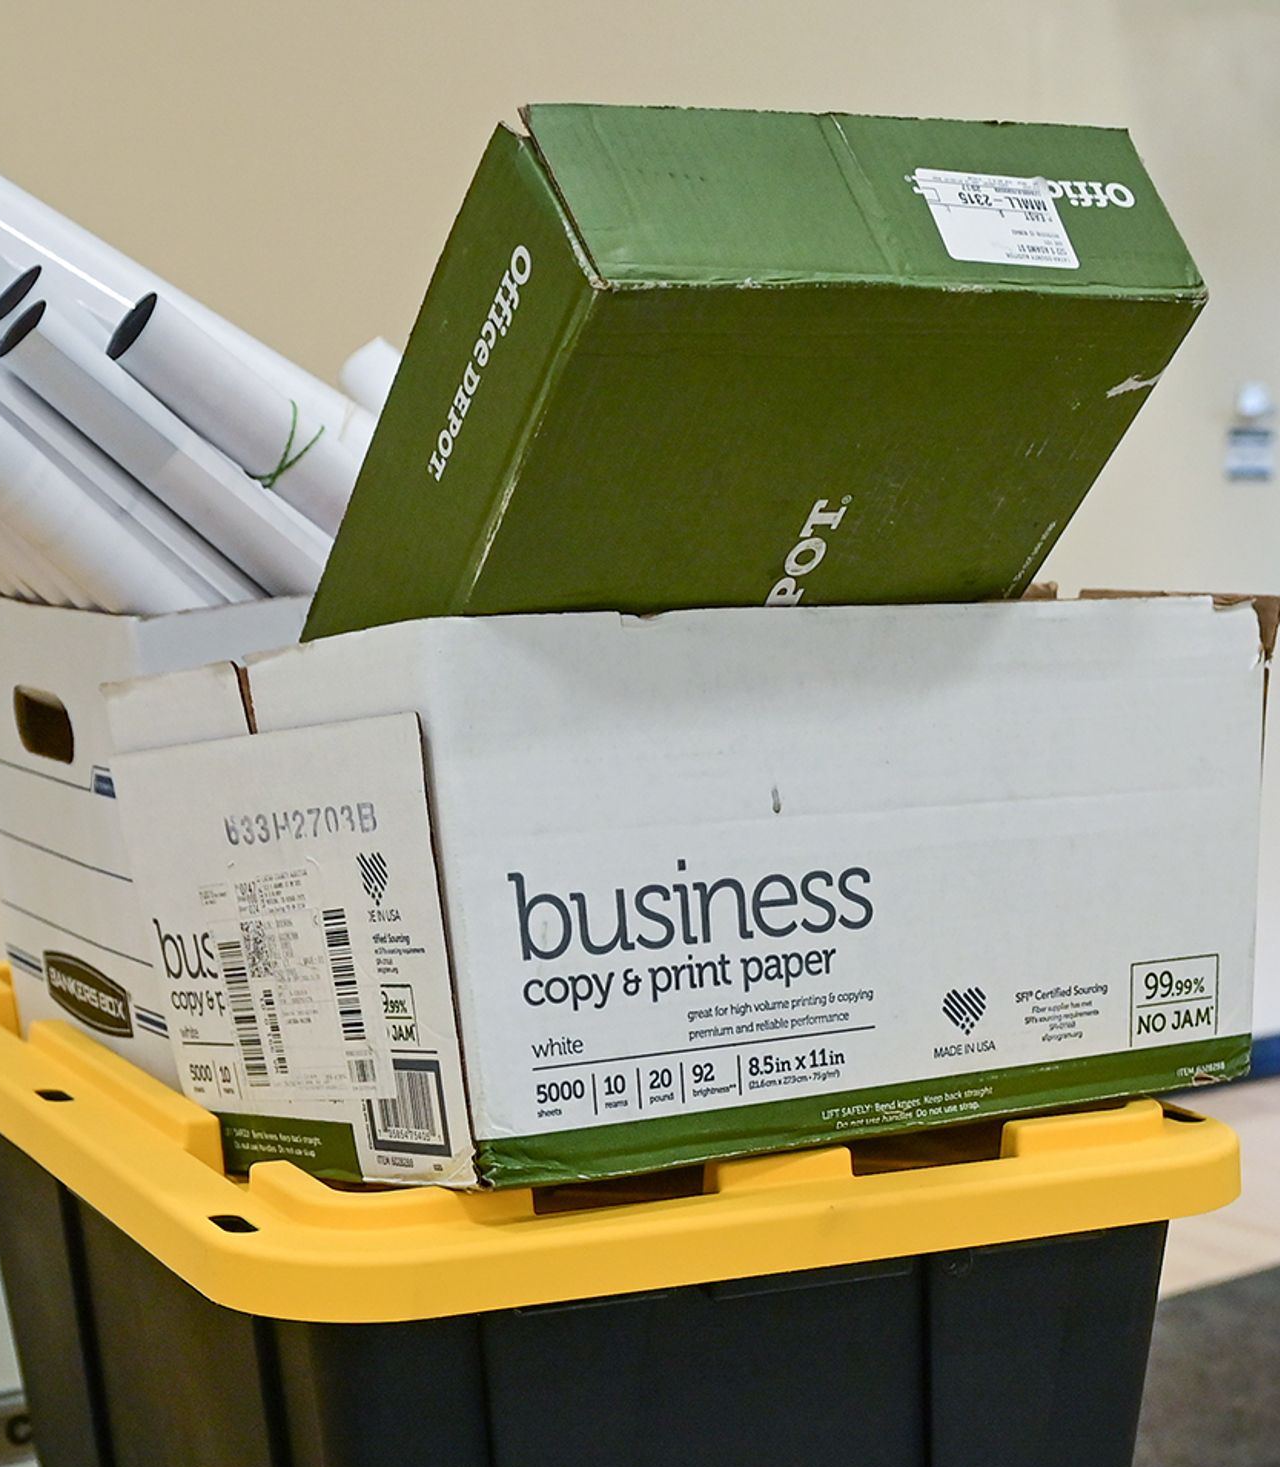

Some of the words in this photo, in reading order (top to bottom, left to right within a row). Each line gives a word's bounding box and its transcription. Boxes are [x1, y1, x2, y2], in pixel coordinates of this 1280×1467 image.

[474, 245, 532, 367] Office
[763, 499, 847, 607] POT
[385, 908, 402, 922] USA
[507, 858, 874, 961] business
[522, 971, 615, 1011] copy
[623, 967, 642, 997] &
[648, 953, 732, 1003] print
[739, 947, 837, 993] paper
[1144, 970, 1205, 1000] 99.99%
[171, 990, 204, 1016] copy
[206, 990, 215, 1010] &
[1035, 985, 1072, 1001] Certified
[1073, 983, 1108, 996] Sourcing
[687, 1008, 713, 1022] great
[714, 1006, 729, 1018] for
[730, 1003, 753, 1017] high
[754, 998, 790, 1012] volume
[791, 994, 827, 1010] printing
[828, 992, 836, 1004] &
[837, 988, 874, 1003] copying
[688, 1026, 735, 1042] premium
[735, 1022, 755, 1034] and
[756, 1016, 790, 1031] reliable
[791, 1011, 850, 1029] performance
[1136, 1012, 1167, 1035] NO
[531, 1037, 584, 1059] white
[933, 1043, 963, 1059] MADE
[964, 1043, 976, 1054] IN
[976, 1040, 996, 1052] USA
[189, 1064, 213, 1082] 5000
[692, 1062, 715, 1084] 92
[795, 1055, 807, 1070] x
[220, 1066, 231, 1083] 10
[604, 1074, 626, 1096] 10
[649, 1068, 673, 1090] 20
[536, 1079, 585, 1104] 5000
[649, 1092, 674, 1105] pound
[537, 1108, 562, 1118] sheets
[821, 1109, 840, 1120] LIFT
[923, 1095, 944, 1106] Keep
[944, 1090, 963, 1101] back
